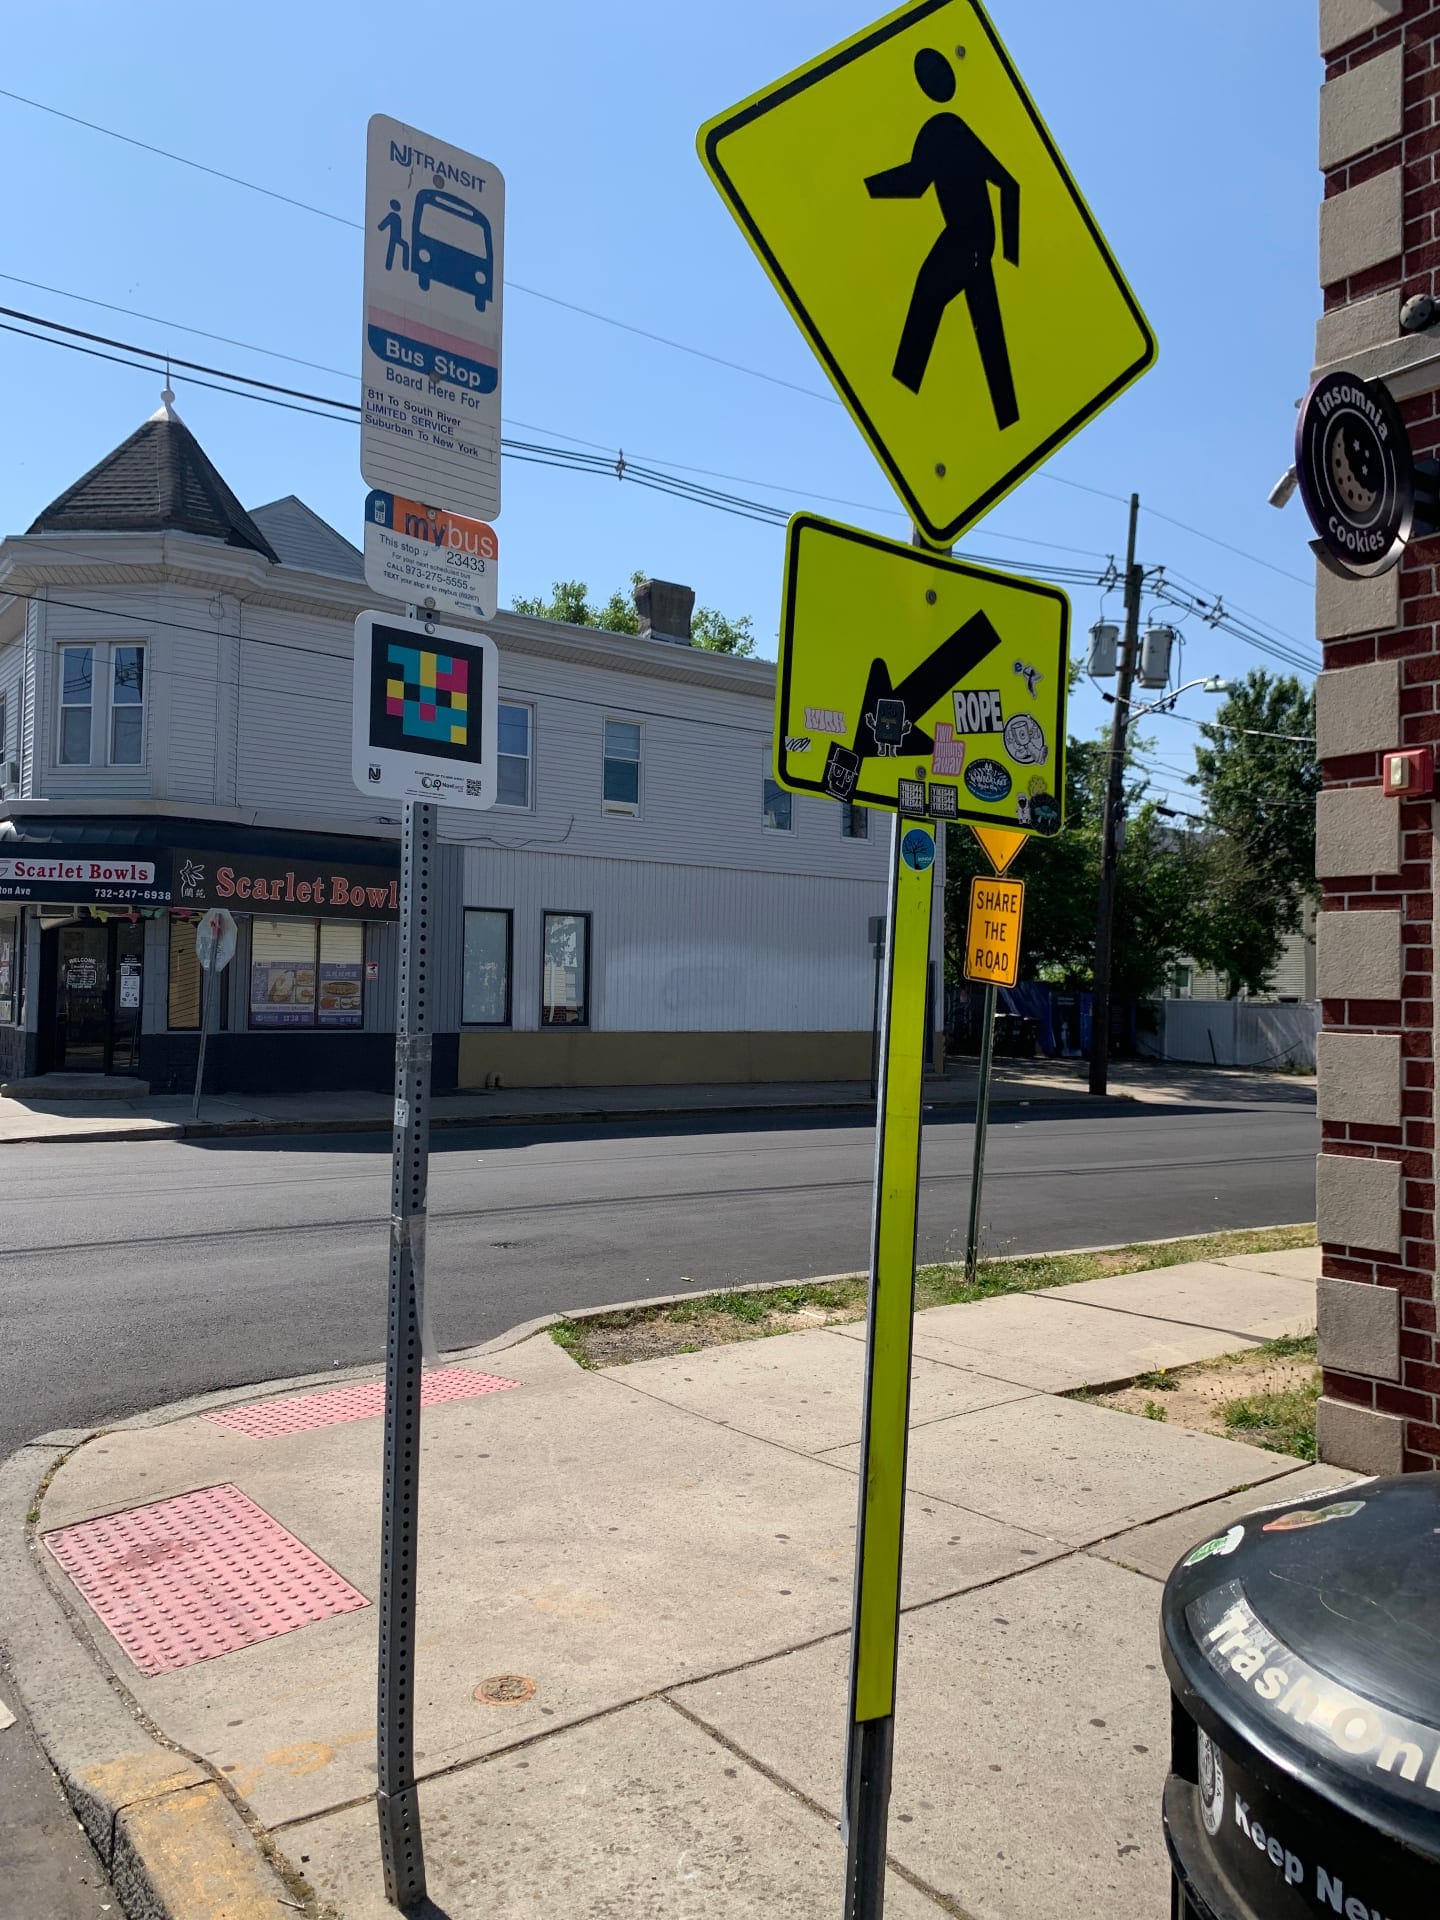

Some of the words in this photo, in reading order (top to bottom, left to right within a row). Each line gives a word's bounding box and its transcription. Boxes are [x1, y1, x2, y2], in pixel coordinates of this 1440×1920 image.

[386, 337, 425, 367] Bus
[434, 355, 481, 387] Stop
[386, 367, 423, 391] Board
[428, 382, 455, 402] Here
[461, 393, 480, 409] For
[366, 402, 407, 421] LIMITED
[411, 416, 454, 435] SERVICE
[368, 389, 384, 402] 811
[388, 395, 399, 406] To
[404, 400, 433, 417] South
[437, 411, 461, 427] River
[1315, 384, 1389, 442] insomnia
[365, 414, 413, 436] Suburban
[418, 430, 428, 441] To
[433, 435, 454, 449] New
[458, 442, 479, 457] York
[1328, 515, 1385, 553] cookies
[379, 534, 398, 548] This
[401, 542, 420, 556] stop
[446, 551, 485, 573] 23433
[392, 552, 402, 560] For
[384, 570, 399, 581] TEXT
[386, 562, 404, 573] CALL
[405, 565, 468, 590] 973-275-5555
[953, 692, 1003, 732] ROPE
[14, 861, 83, 879] Scarlet
[89, 863, 149, 881] Bowls
[215, 866, 325, 904] Scarlet
[330, 876, 401, 909] Bowl
[15, 886, 31, 895] Ave
[95, 888, 171, 900] 732-247-6938
[976, 890, 1018, 913] SHARE
[984, 920, 1007, 942] THE
[975, 949, 1009, 971] ROAD
[1207, 1604, 1321, 1725] Trash
[1235, 1792, 1304, 1886] Keep
